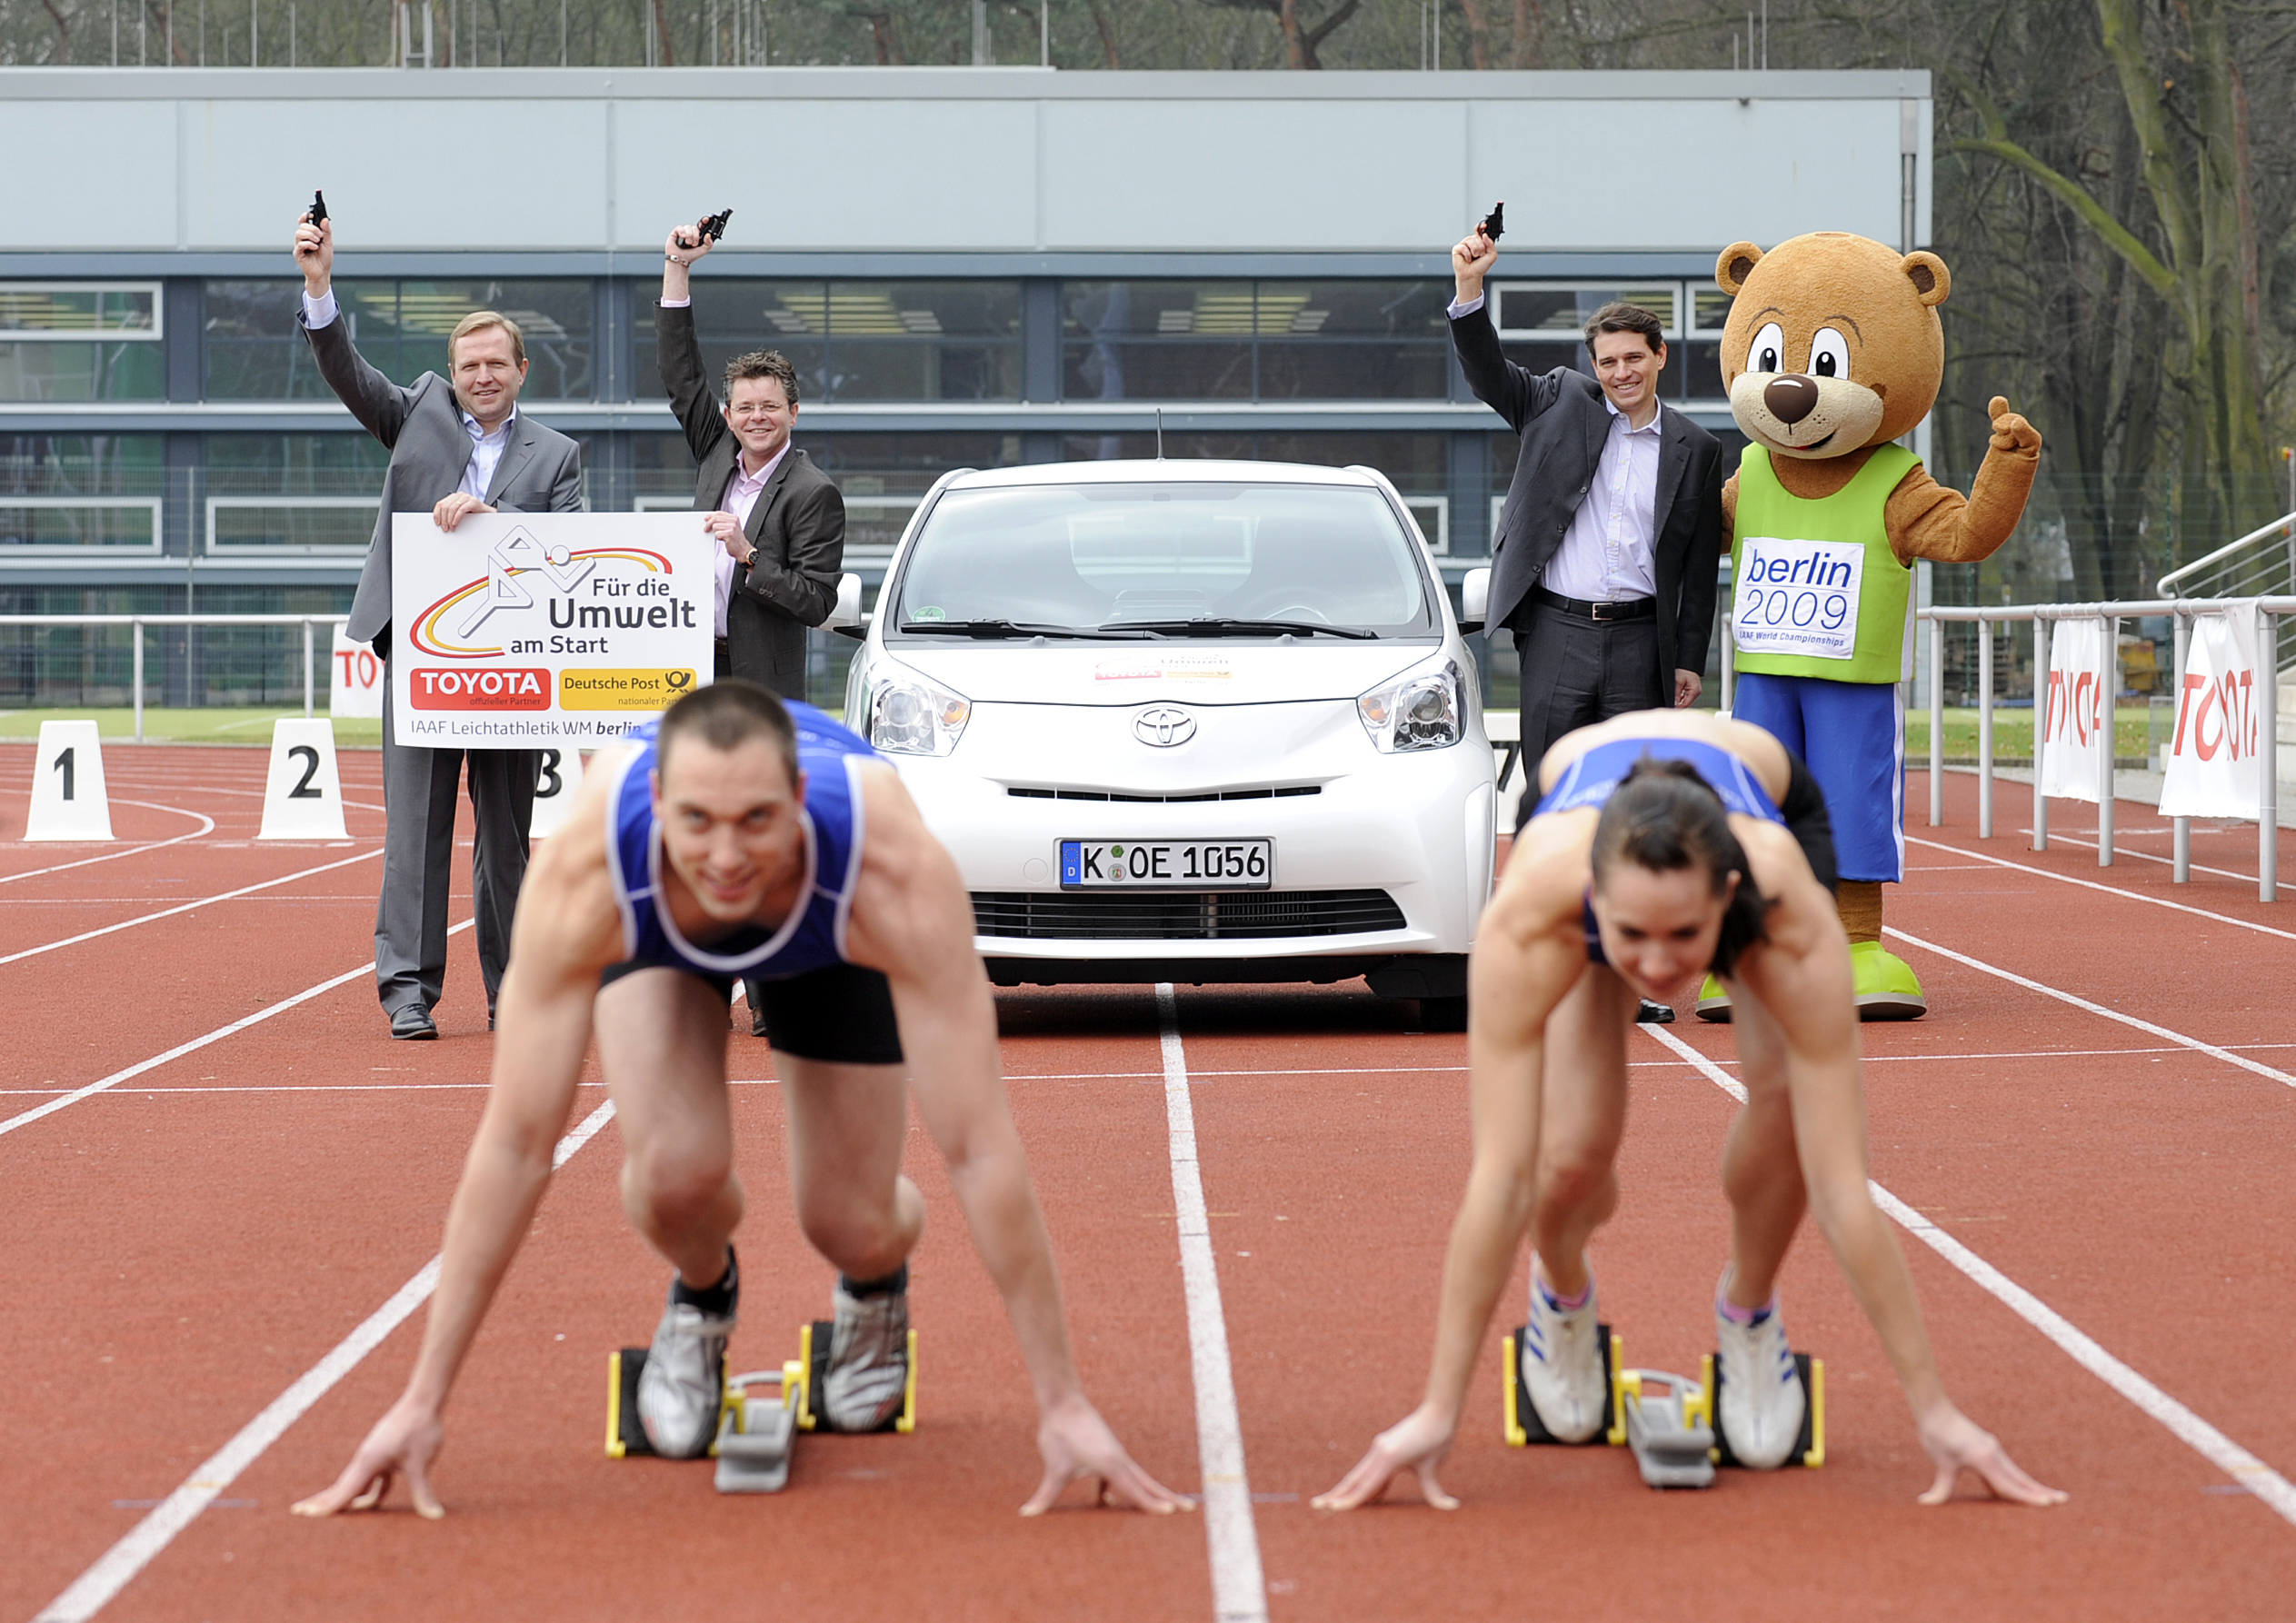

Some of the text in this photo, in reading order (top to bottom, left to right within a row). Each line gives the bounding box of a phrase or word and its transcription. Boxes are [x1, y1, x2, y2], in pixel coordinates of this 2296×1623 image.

[1746, 549, 1852, 588] berlin
[593, 578, 670, 596] Für die
[549, 598, 696, 629] Umwelt
[1741, 589, 1848, 630] 2009
[511, 635, 609, 653] am Start
[1739, 631, 1845, 647] IAAF World Championships
[420, 672, 542, 695] TOYOTA
[564, 677, 660, 689] Deutsche Post
[470, 697, 542, 705] offizieller Partner
[618, 697, 659, 705] nationaler
[411, 721, 447, 733] IAAF
[452, 721, 560, 735] Leichtathletik
[563, 722, 592, 735] WM
[54, 747, 75, 801] 1
[287, 745, 323, 799] 2
[1491, 741, 1520, 793] 7
[1068, 846, 1265, 878] D K OE 1056
